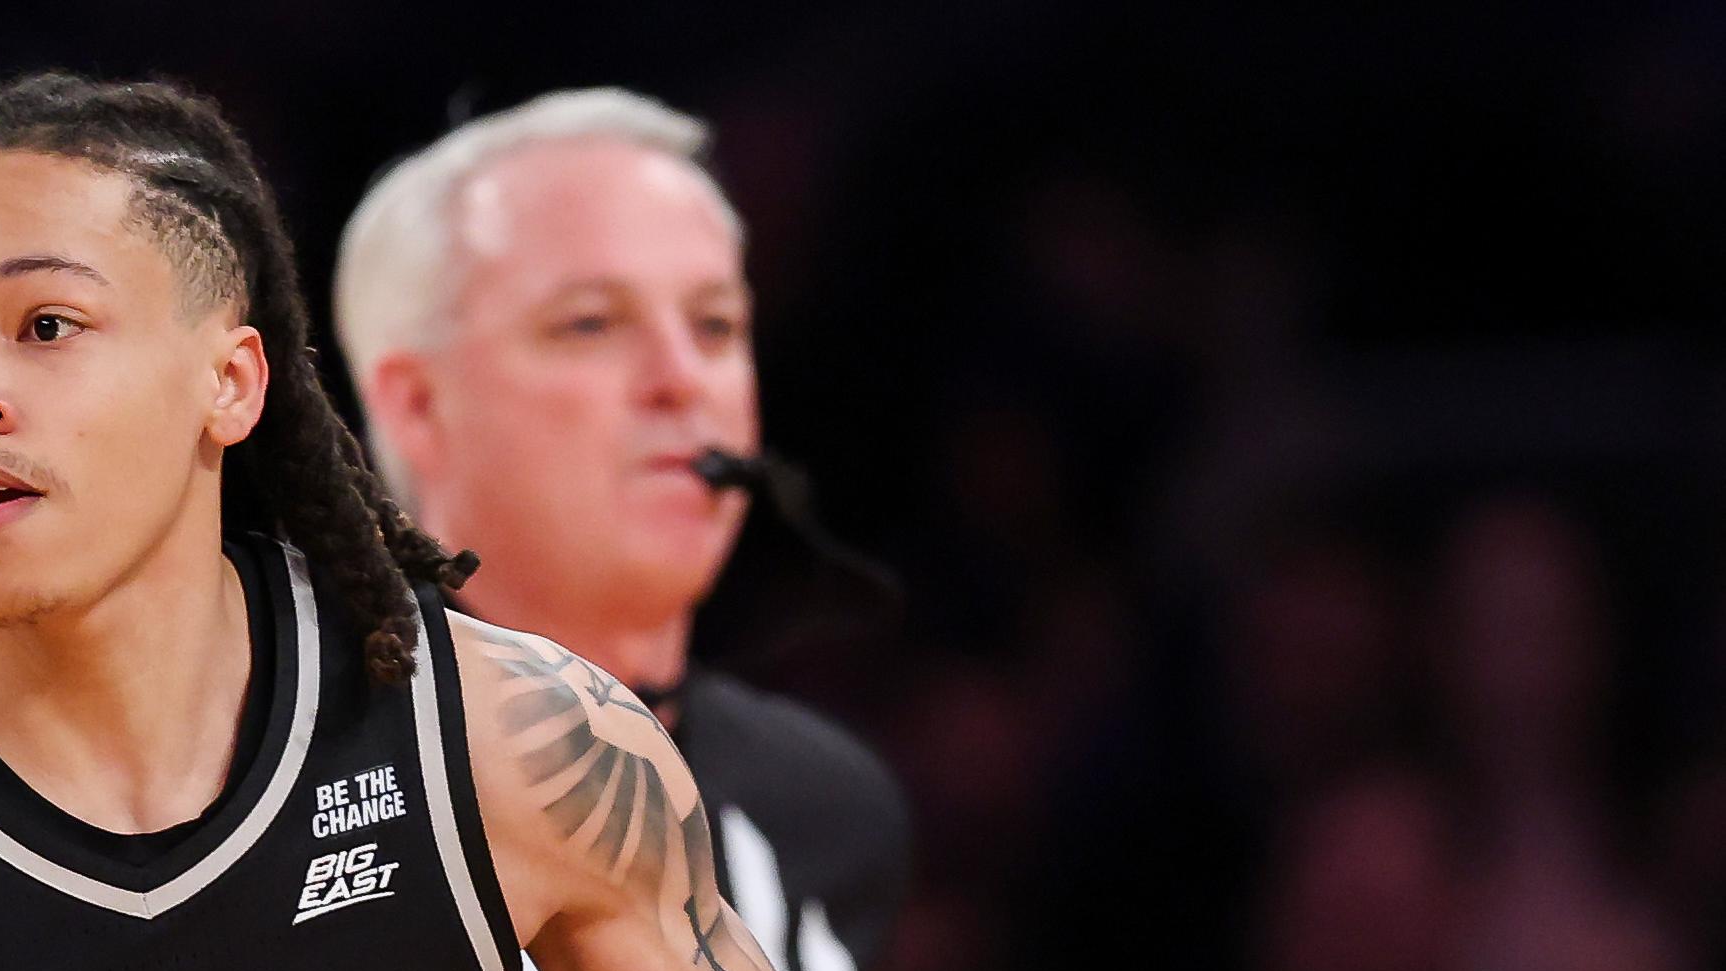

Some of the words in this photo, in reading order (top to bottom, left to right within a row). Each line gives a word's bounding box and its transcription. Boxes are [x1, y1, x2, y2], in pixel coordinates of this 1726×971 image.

[316, 779, 350, 811] BE
[355, 766, 398, 799] THE
[312, 791, 407, 839] CHANGE
[298, 862, 400, 910] EAST
[305, 843, 378, 885] BIG
